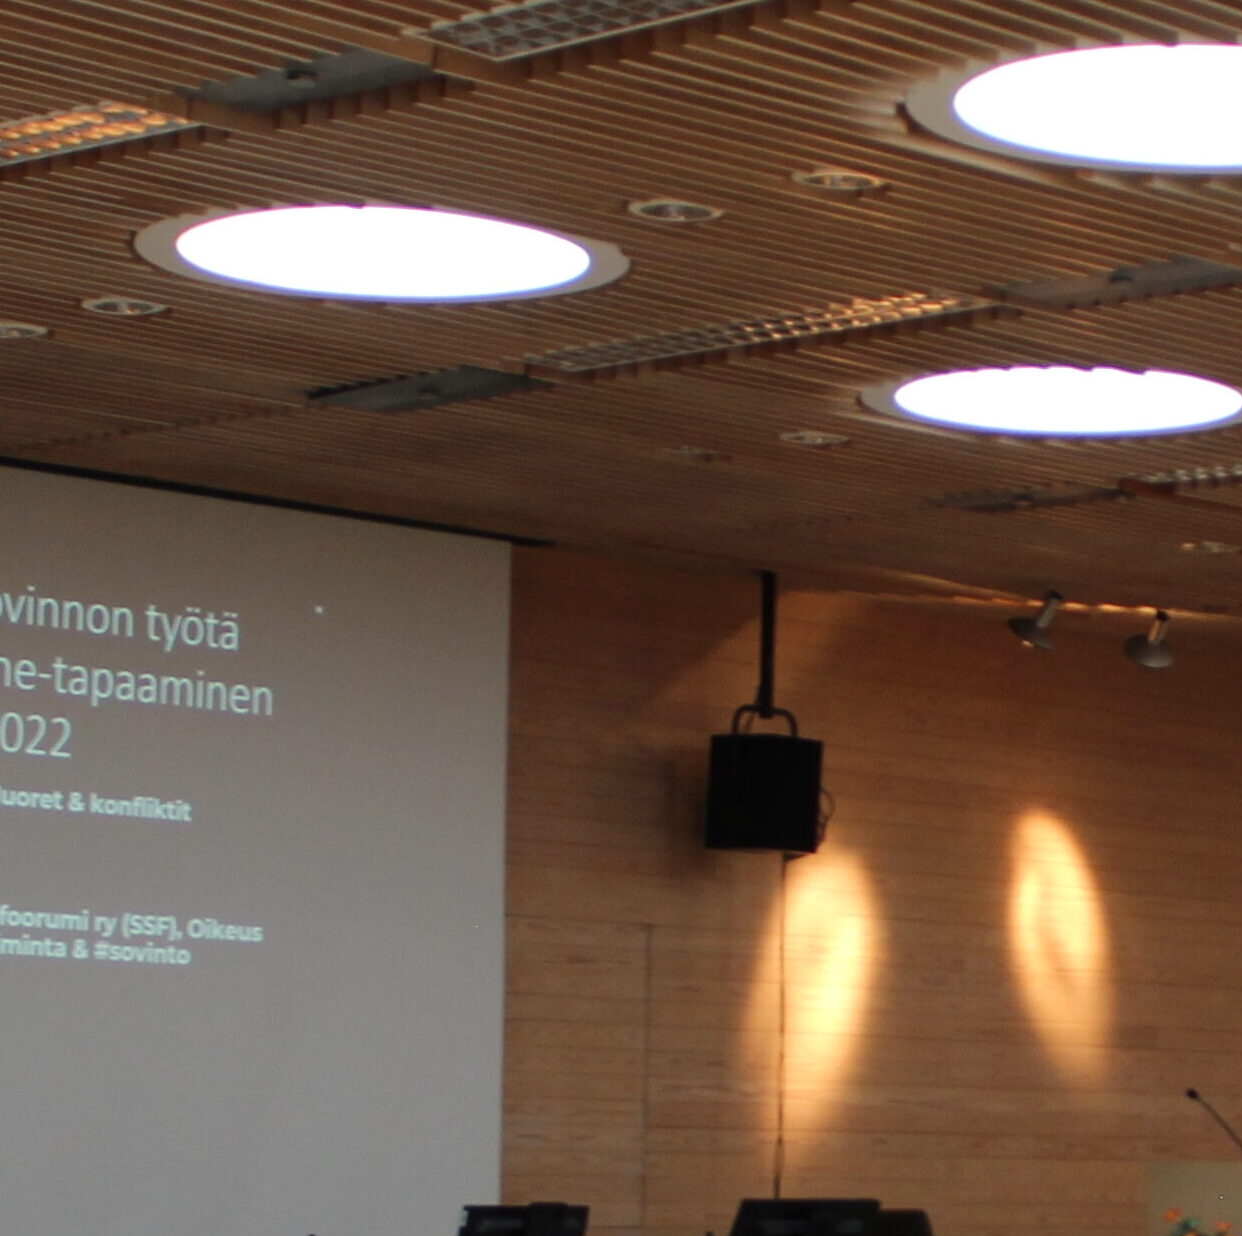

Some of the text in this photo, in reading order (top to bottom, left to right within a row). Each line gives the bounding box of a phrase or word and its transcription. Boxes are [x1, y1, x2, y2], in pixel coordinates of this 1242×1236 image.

[0, 585, 240, 653] vinnon työtä
[0, 786, 192, 822] uoret & konfliktit
[94, 915, 117, 938] ry
[121, 912, 184, 941] (SSF),
[187, 915, 264, 942] Oikeus
[71, 938, 88, 959] &
[94, 939, 191, 966] #sovinto
